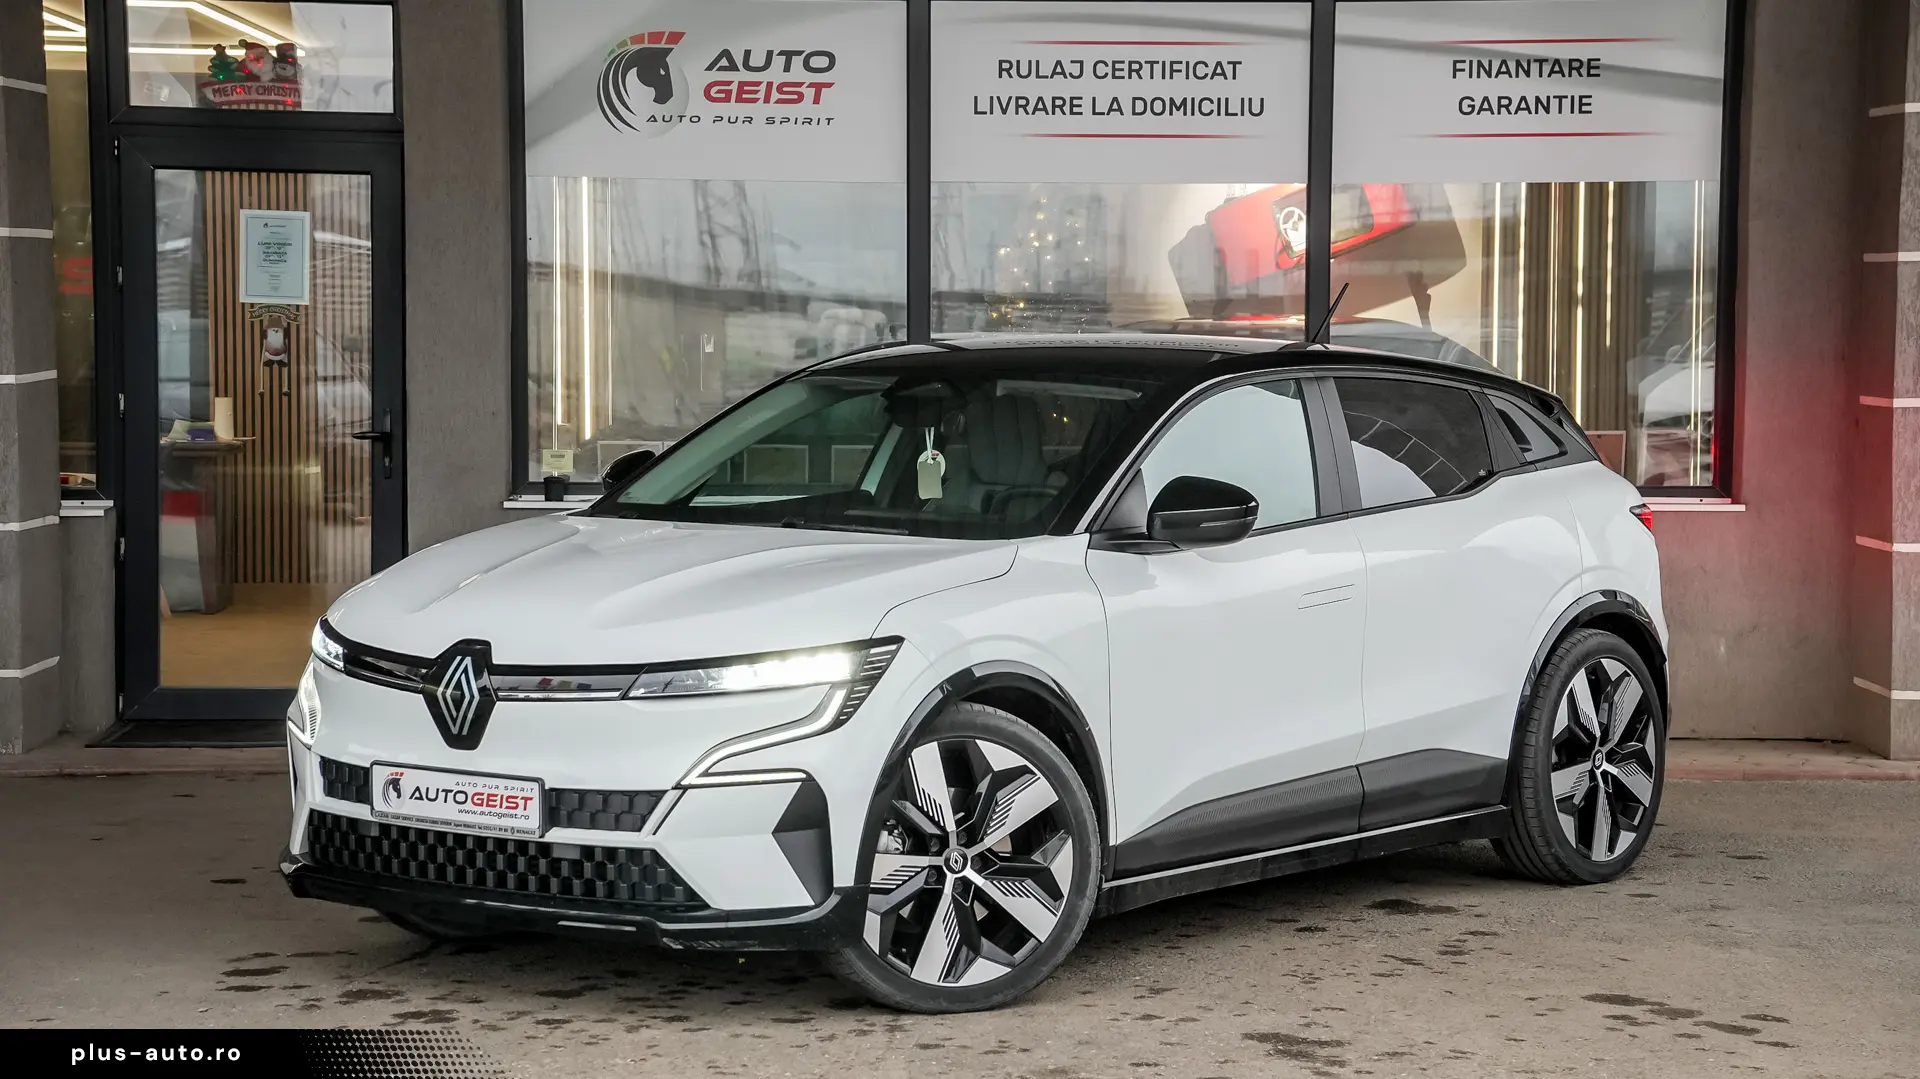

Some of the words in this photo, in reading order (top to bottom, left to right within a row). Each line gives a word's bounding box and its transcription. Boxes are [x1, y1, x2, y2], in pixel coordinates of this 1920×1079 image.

[703, 48, 837, 74] AUTO
[997, 59, 1085, 80] RULAJ
[1092, 60, 1243, 81] CERTIFICAT
[1452, 58, 1602, 79] FINANTARE
[212, 84, 253, 98] MERRY
[703, 80, 836, 105] GEIST
[972, 95, 1084, 116] LIVRARE
[1091, 96, 1125, 116] LA
[1131, 97, 1265, 117] DOMICILIU
[1458, 95, 1593, 116] GARANTIE
[645, 114, 701, 124] AUTO
[712, 115, 754, 125] PUR
[765, 116, 836, 126] SPIRIT
[454, 780, 478, 788] AUTO
[482, 783, 500, 791] PUR
[504, 785, 535, 793] SPIRIT
[457, 807, 531, 820] www.autogeist.ro
